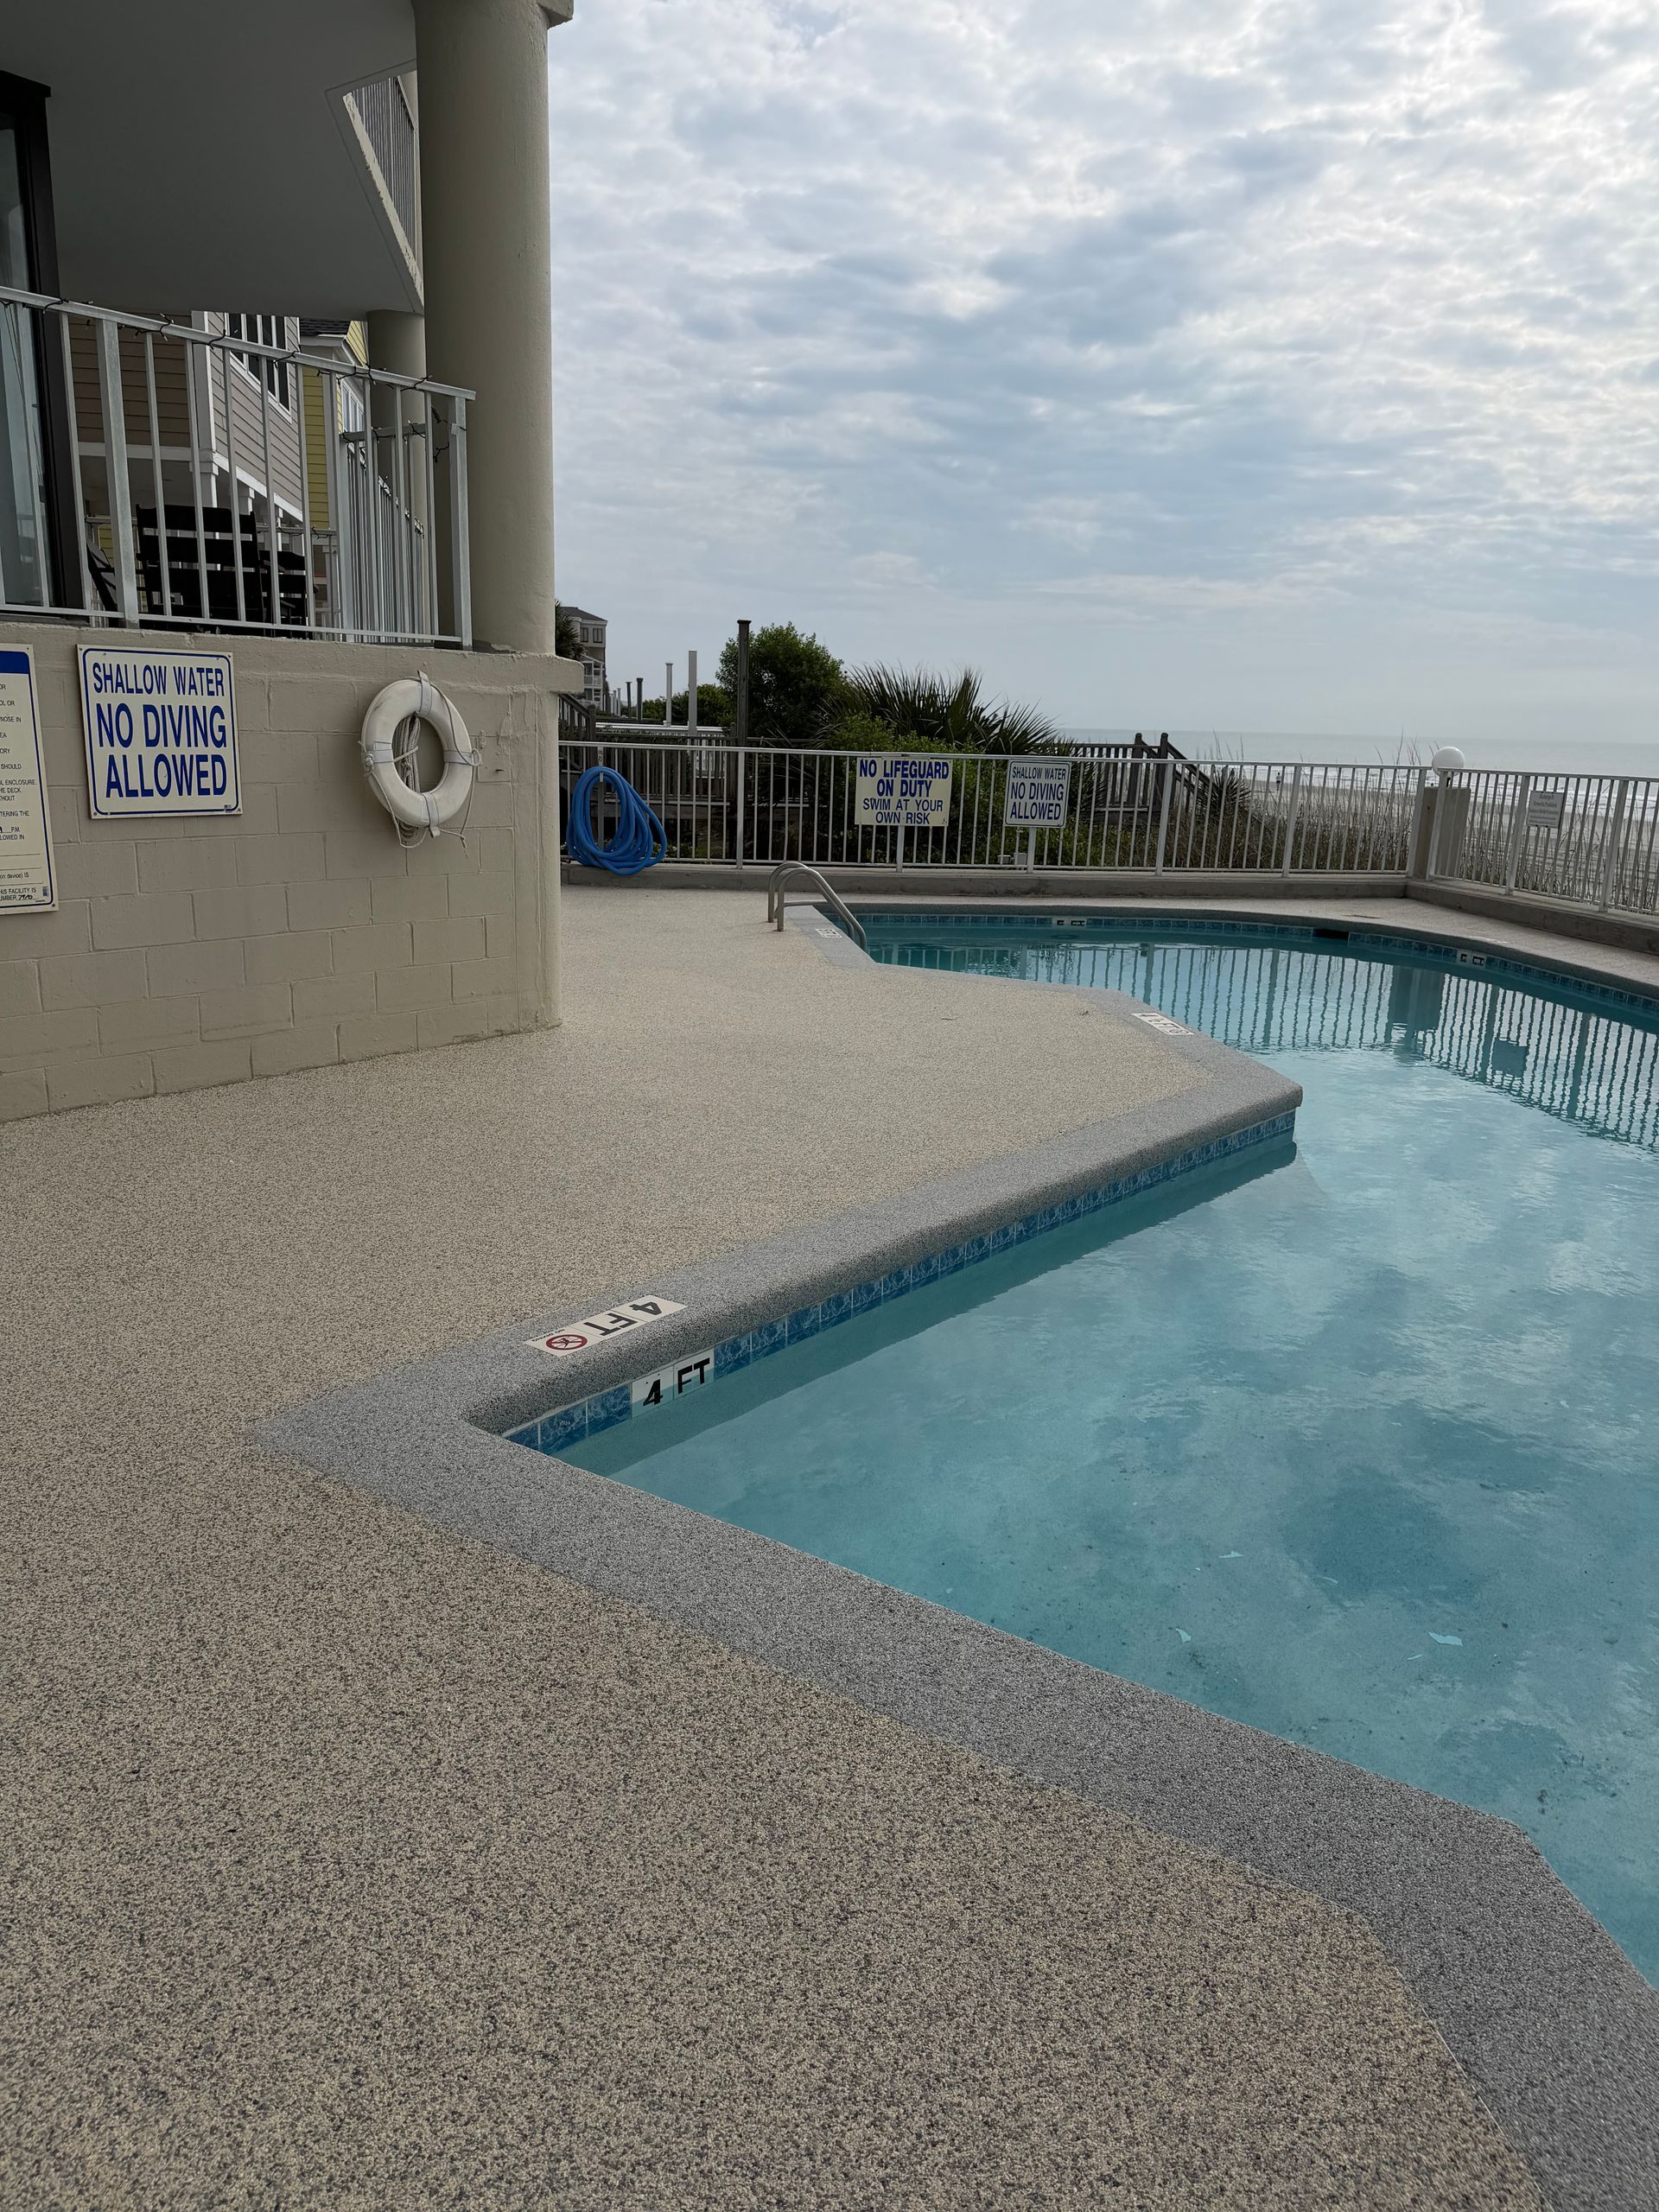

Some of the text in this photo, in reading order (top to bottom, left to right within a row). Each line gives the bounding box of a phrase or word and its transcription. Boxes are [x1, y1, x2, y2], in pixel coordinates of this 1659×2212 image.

[92, 662, 225, 696] SHALLOW WATER
[96, 702, 226, 748] NO DIVING
[105, 753, 227, 798] ALLOWED
[859, 760, 950, 779] NO LIFEGUARD
[1012, 766, 1066, 780] SHALLOW WATER
[876, 779, 932, 798] ON DUTY
[1010, 782, 1064, 801] NO DIVING
[862, 798, 944, 812] SWIM AT YOUR
[1010, 801, 1061, 820] ALLOWED
[875, 811, 931, 824] OWN RISK
[583, 1301, 663, 1337] 4 FT
[642, 1357, 711, 1407] 4 FT
